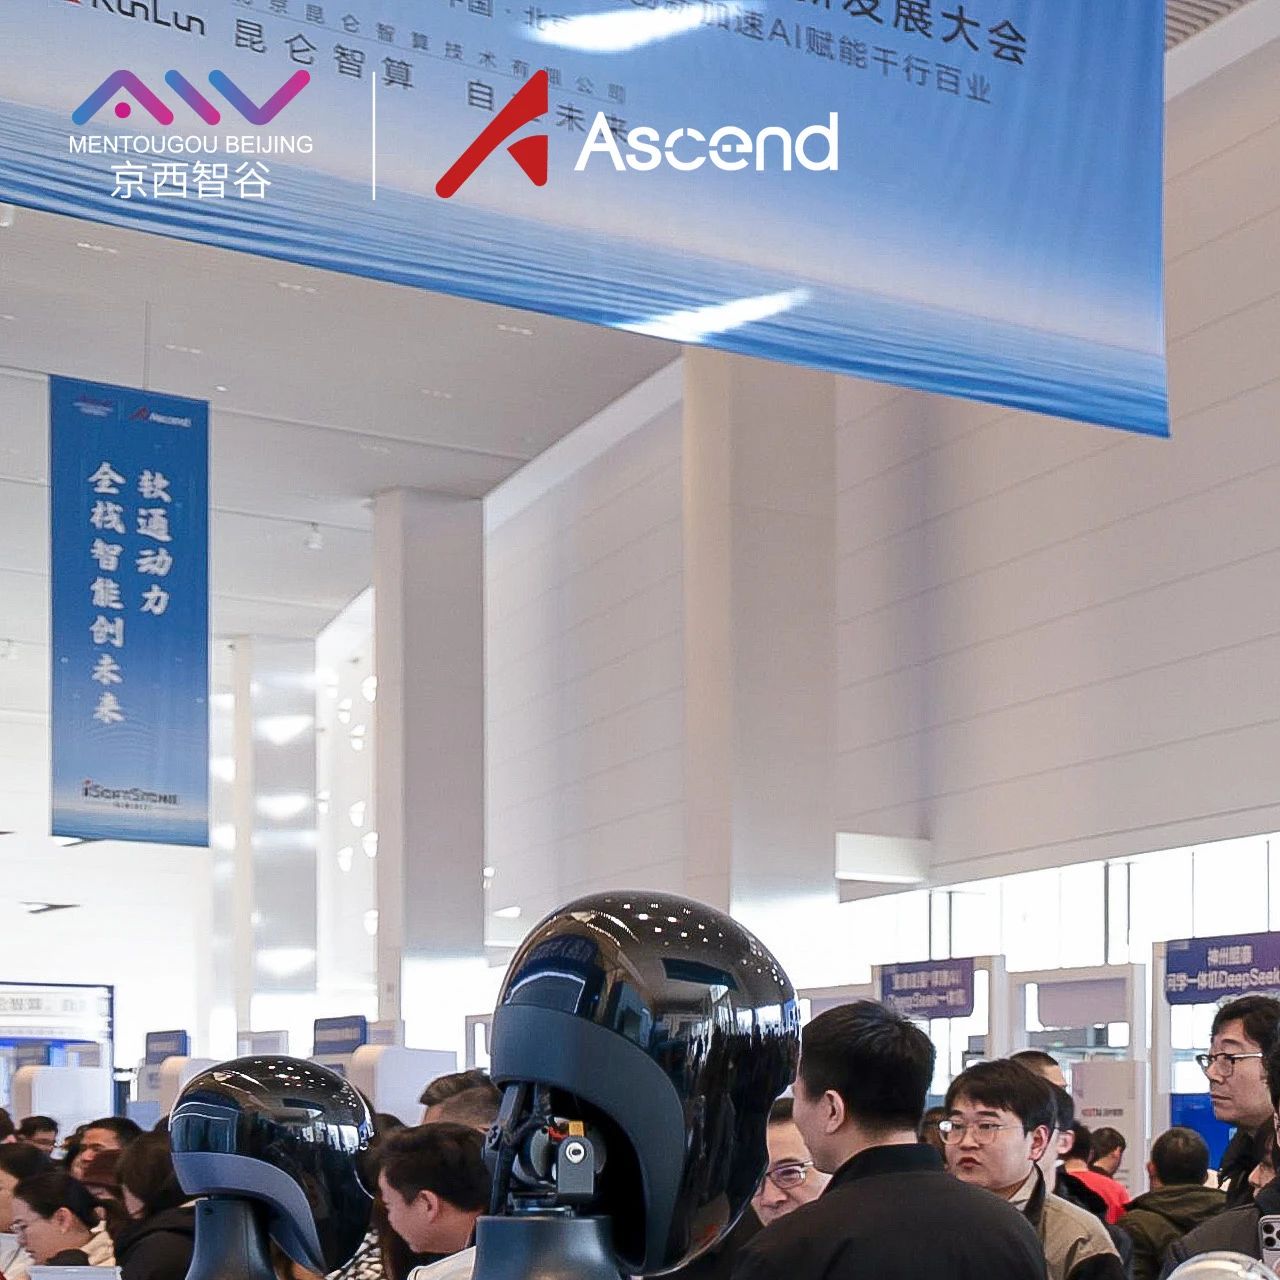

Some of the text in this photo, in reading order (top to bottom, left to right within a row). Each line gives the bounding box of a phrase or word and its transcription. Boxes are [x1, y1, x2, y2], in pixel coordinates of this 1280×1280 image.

[234, 17, 629, 144] 昆仑智算 自未来
[87, 461, 128, 725] 全栈智能创未来
[136, 469, 174, 617] 软通动力
